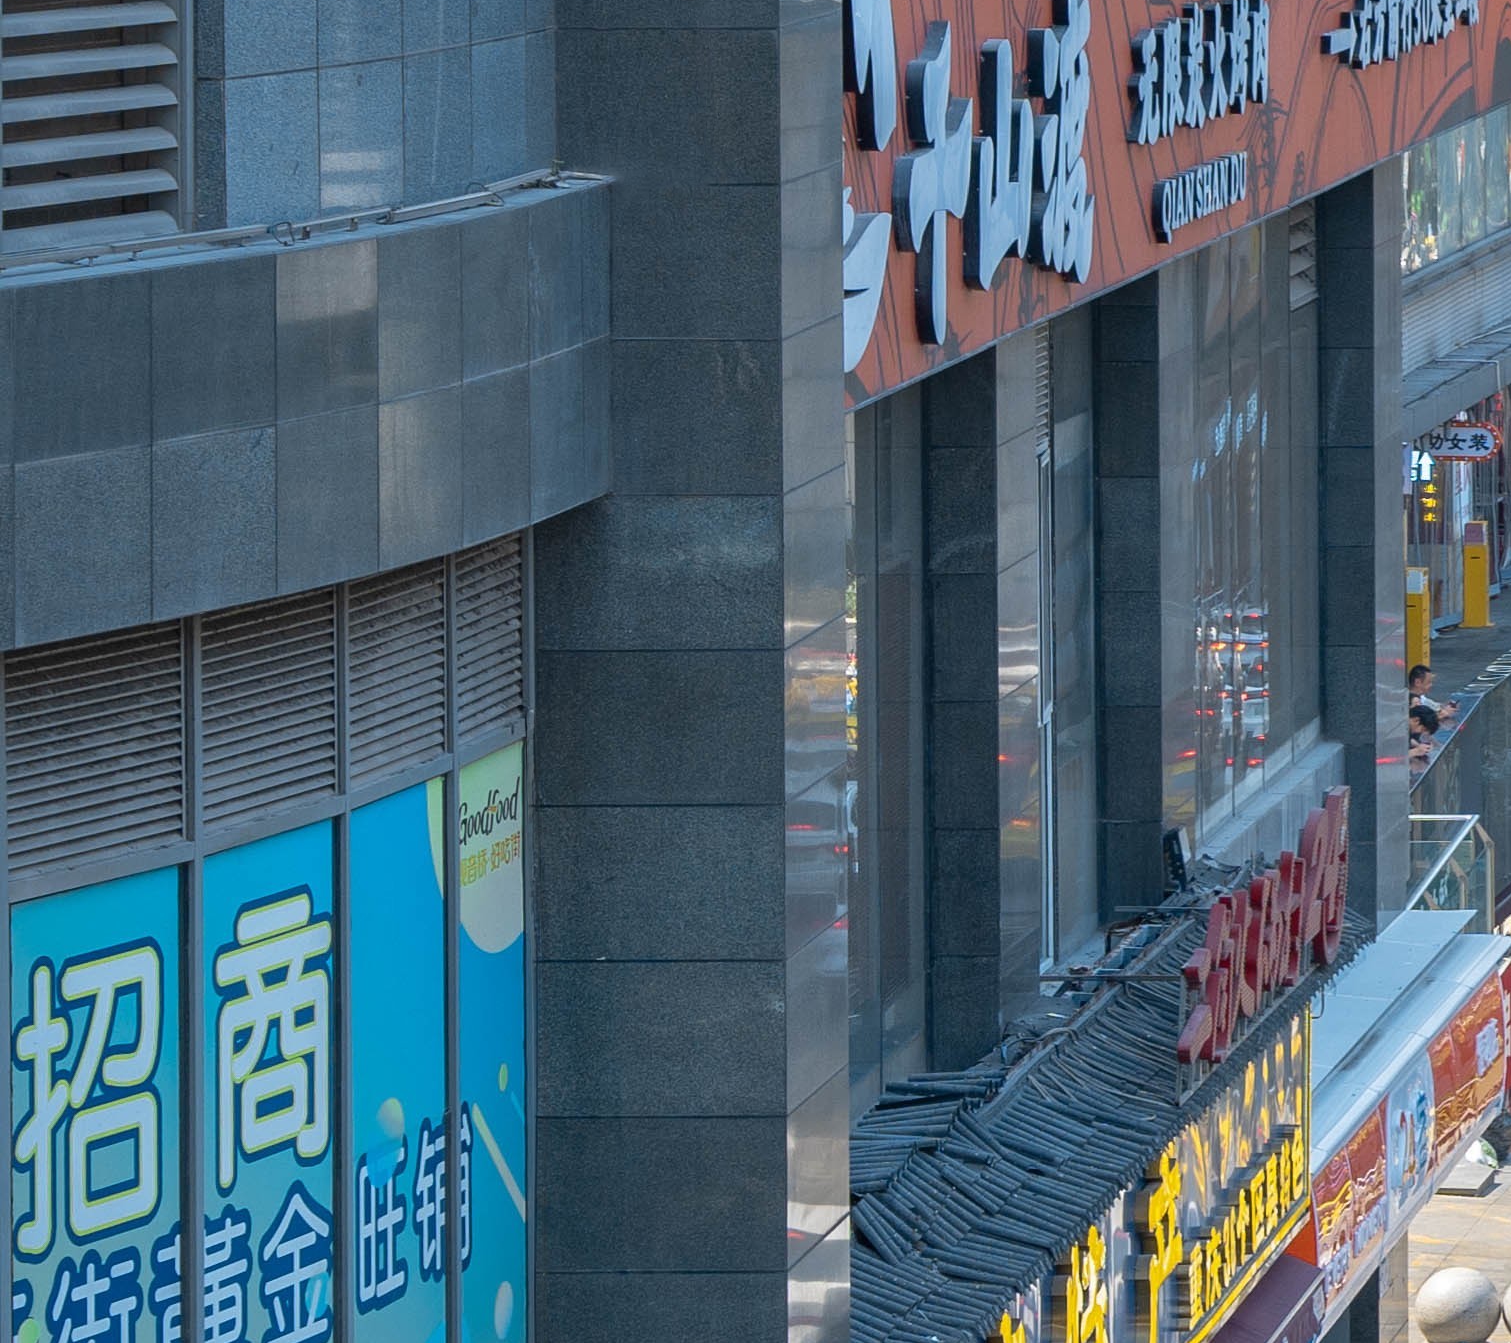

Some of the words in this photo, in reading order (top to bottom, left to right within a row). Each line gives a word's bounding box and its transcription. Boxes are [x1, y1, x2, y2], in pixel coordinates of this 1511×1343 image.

[1162, 166, 1195, 233] QIAN
[1196, 156, 1229, 220] SHAN
[1229, 151, 1248, 204] DU
[15, 892, 335, 1256] 招商
